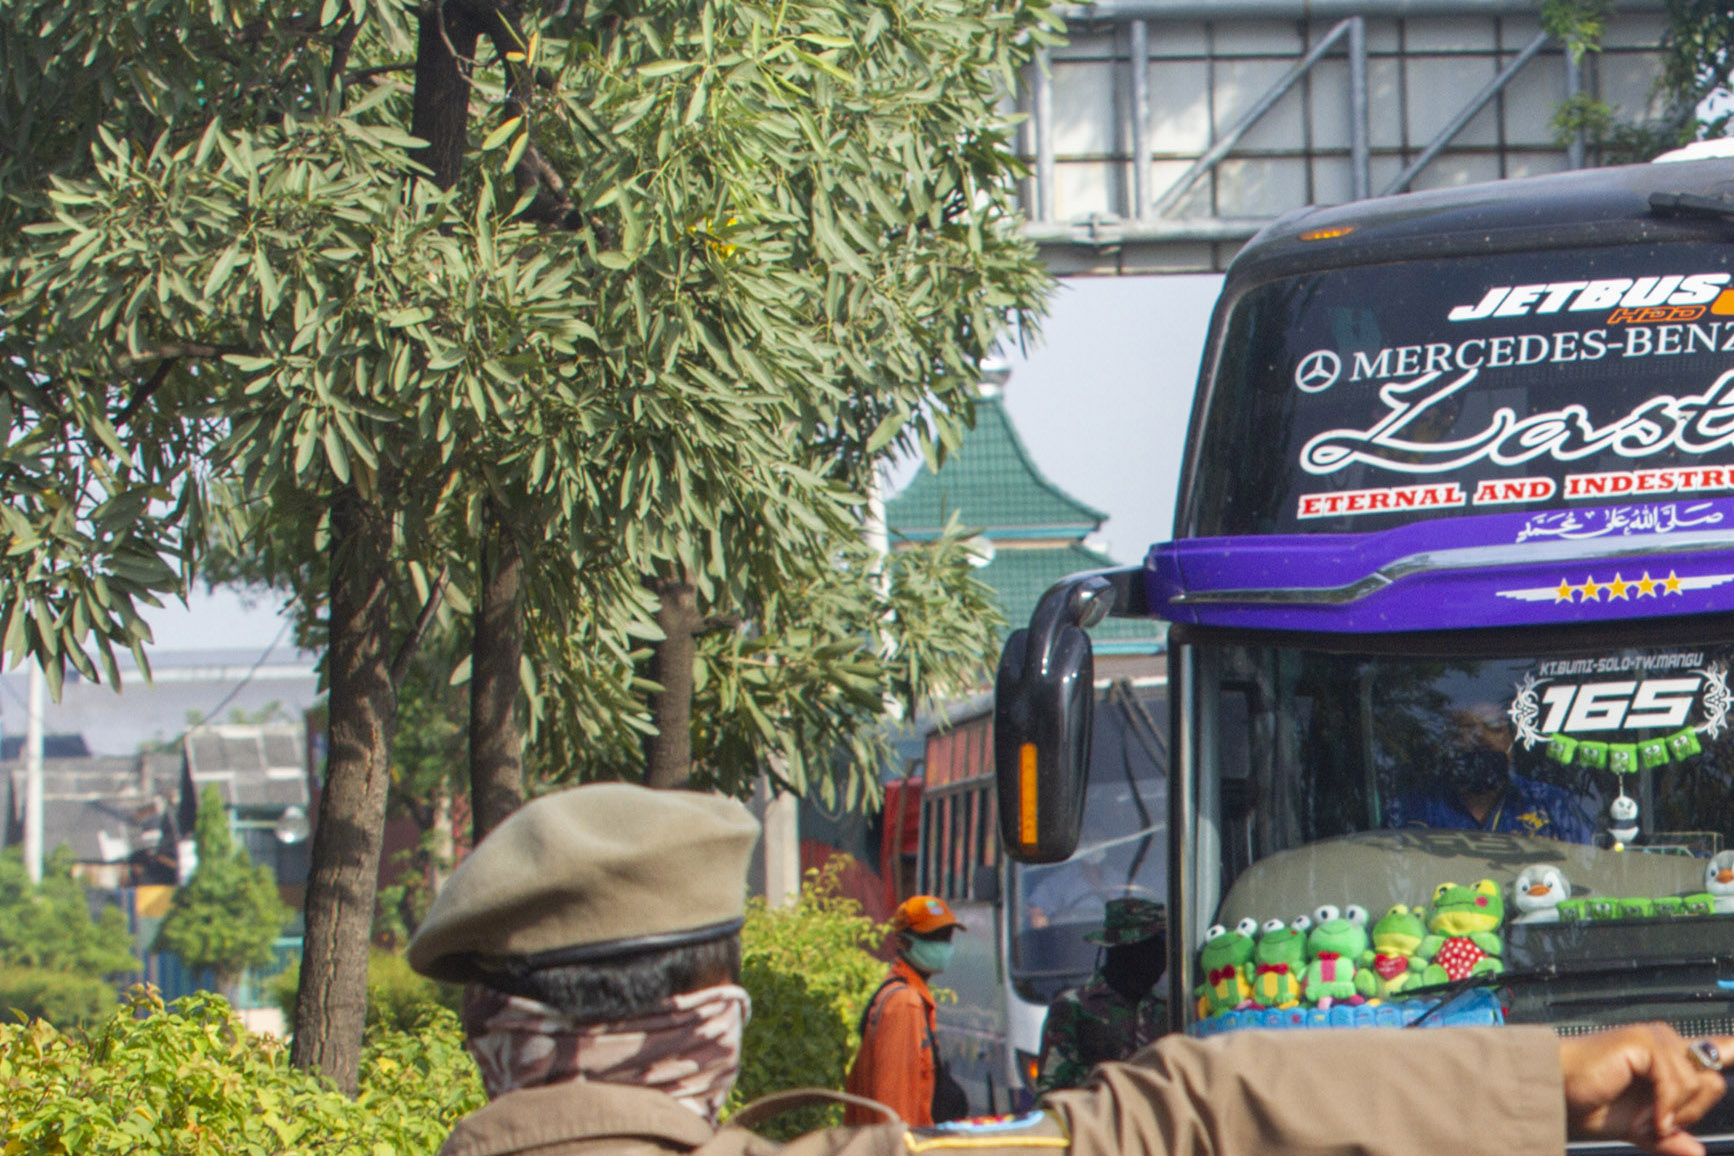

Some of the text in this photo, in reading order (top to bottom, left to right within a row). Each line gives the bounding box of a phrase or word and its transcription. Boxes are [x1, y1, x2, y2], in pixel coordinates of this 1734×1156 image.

[1448, 273, 1731, 321] JETBUS
[1607, 305, 1707, 325] HDD
[1298, 484, 1465, 519] ETERNAL
[1473, 477, 1557, 505] AND
[1541, 678, 1703, 733] 165
